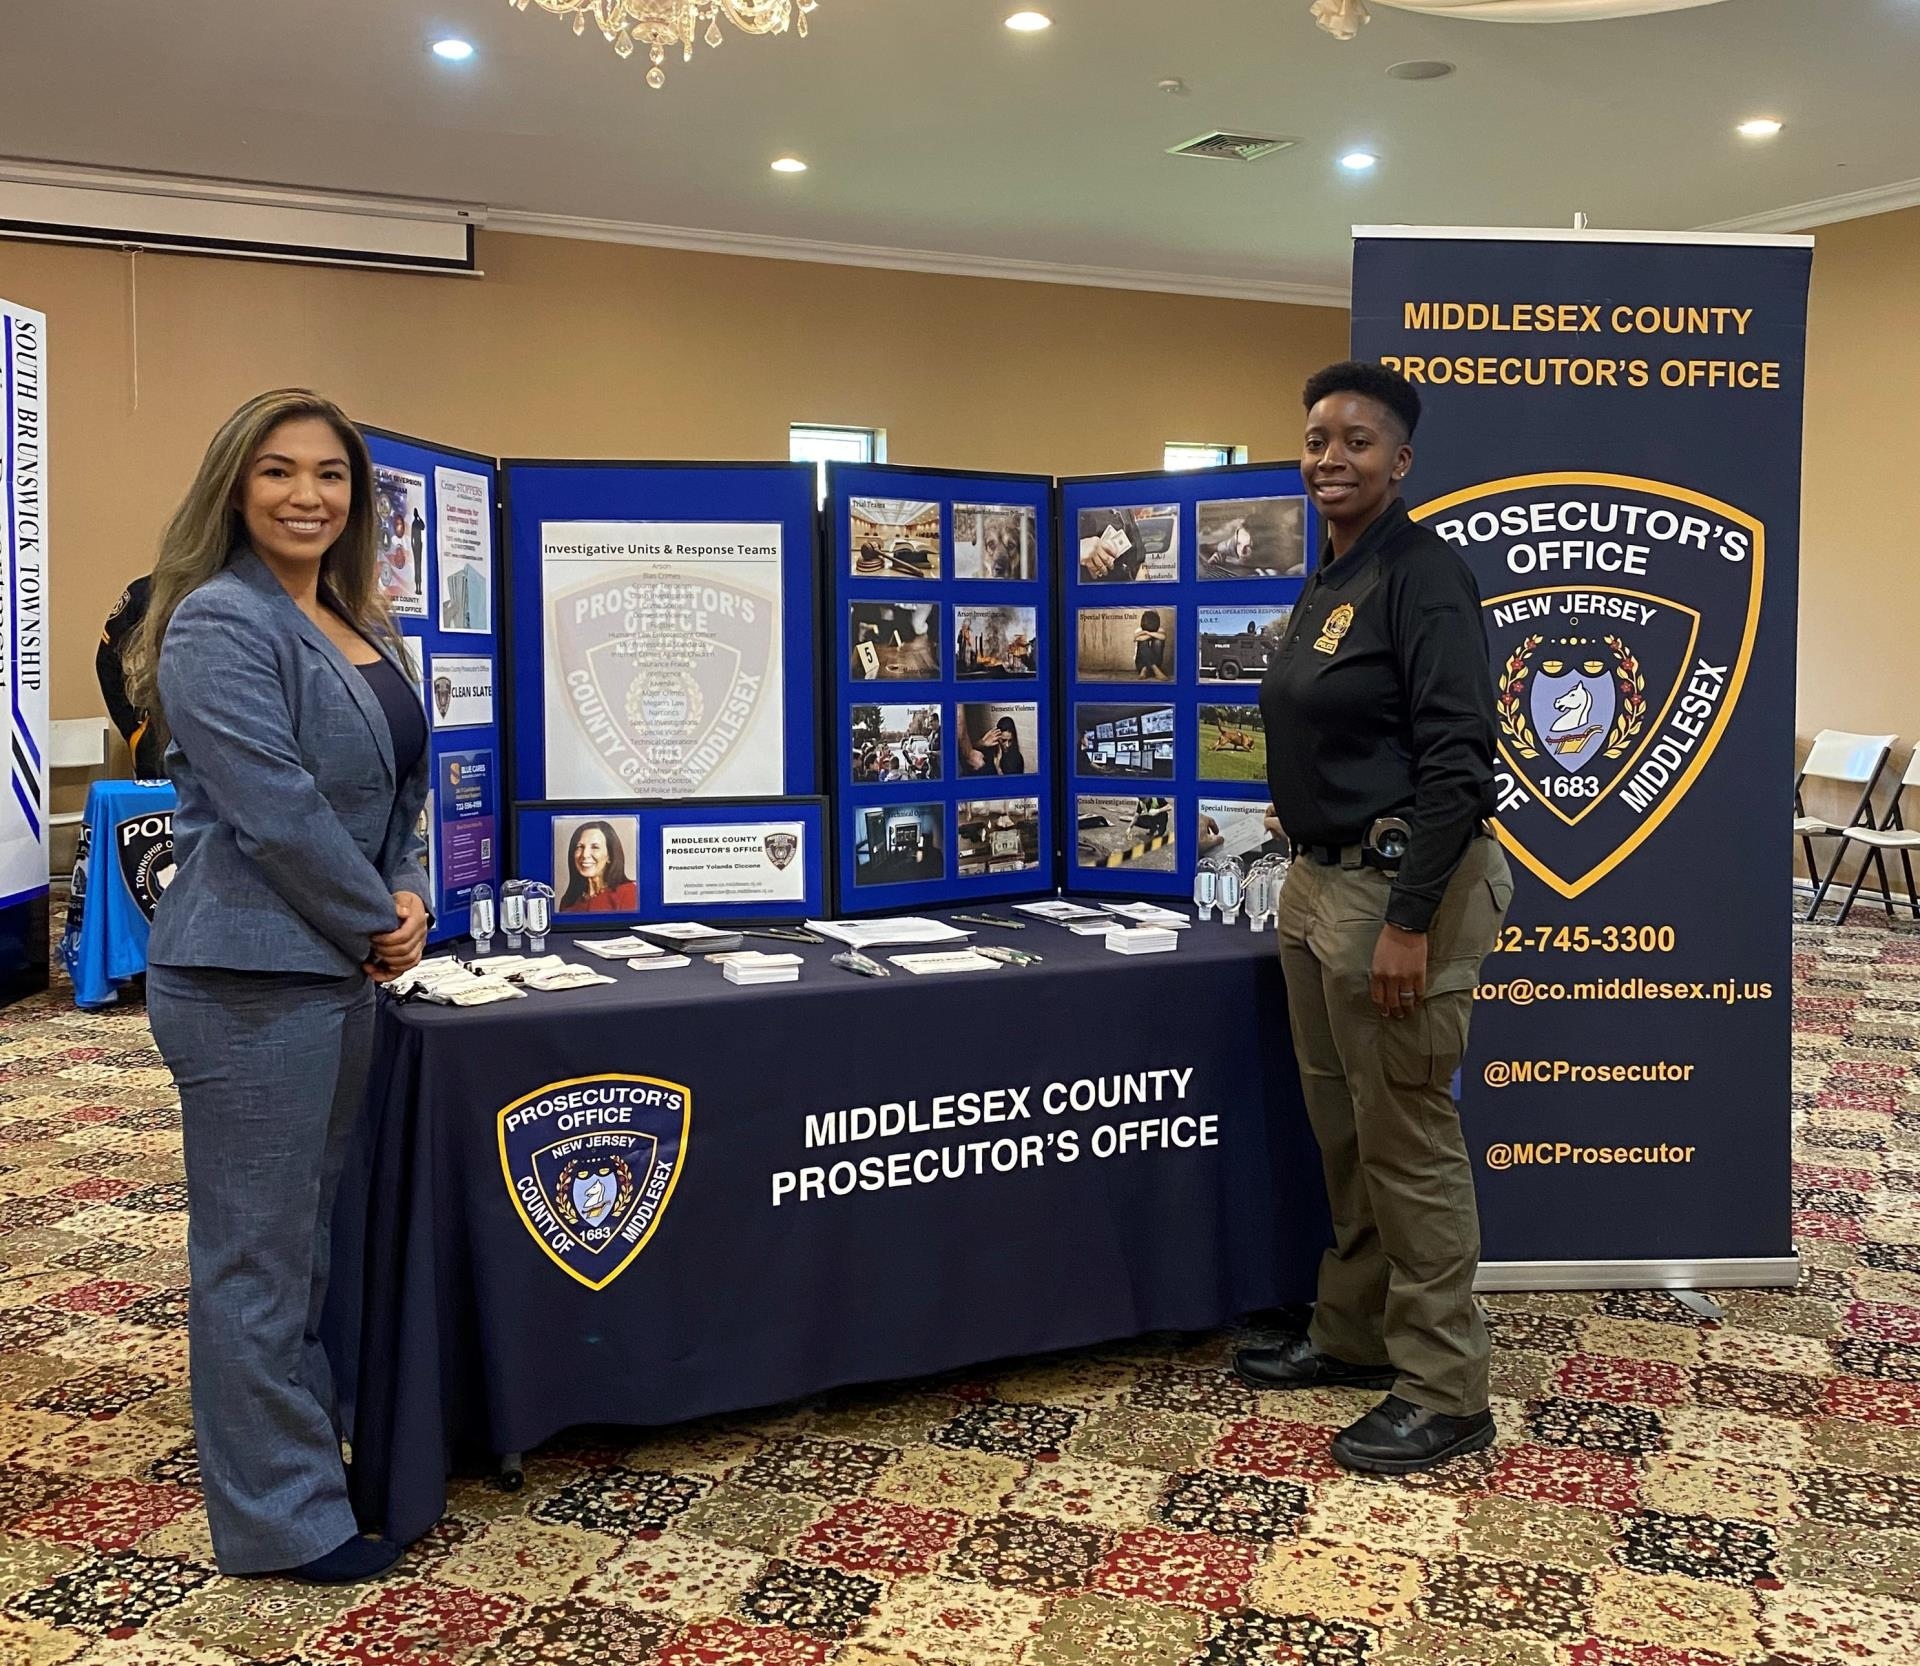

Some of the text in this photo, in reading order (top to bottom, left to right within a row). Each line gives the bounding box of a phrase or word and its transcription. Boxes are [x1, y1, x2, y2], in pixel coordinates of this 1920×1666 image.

[1404, 302, 1753, 334] MIDDLESEX COUNTY
[1380, 356, 1780, 389] PROSECUTOR'S OFFICE
[15, 319, 41, 690] SOUTH BRUNSWICK TOWNSHIP
[1436, 502, 1748, 562] ROSECUTOR'S
[544, 543, 777, 557] Investigative Units & Response Teams
[1506, 541, 1650, 575] OFFICE
[575, 583, 755, 624] PROSECUTOR'S
[1493, 594, 1657, 628] NEW JERSEY
[865, 647, 872, 663] 5
[452, 686, 492, 698] CLEAN SLATE
[567, 669, 628, 755] COUNTY
[685, 671, 761, 785] MIDDLESEX
[1619, 658, 1728, 813] MIDDLESEX
[1539, 776, 1599, 797] 1683
[1201, 804, 1222, 812] Special
[124, 817, 173, 846] POL
[136, 843, 163, 888] TOWNSHIP
[1493, 926, 1675, 952] 2-745-3300
[1472, 978, 1772, 1005] tor@co.middlesex.nj.us
[1484, 1061, 1694, 1088] @MCProsecutor
[506, 1088, 682, 1132] PROSECUTOR'S
[558, 1108, 632, 1131] OFFICE
[804, 1068, 1193, 1148] MIDDLESEX COUNTY
[551, 1136, 636, 1159] NEW JERSEY
[772, 1115, 1219, 1206] PROSECUTOR'S OFFICE
[1487, 1144, 1695, 1170] @MCProsecutor
[517, 1176, 575, 1254] COUNTY OF
[621, 1160, 673, 1243] MIDDLESEX
[579, 1227, 610, 1242] 1683
